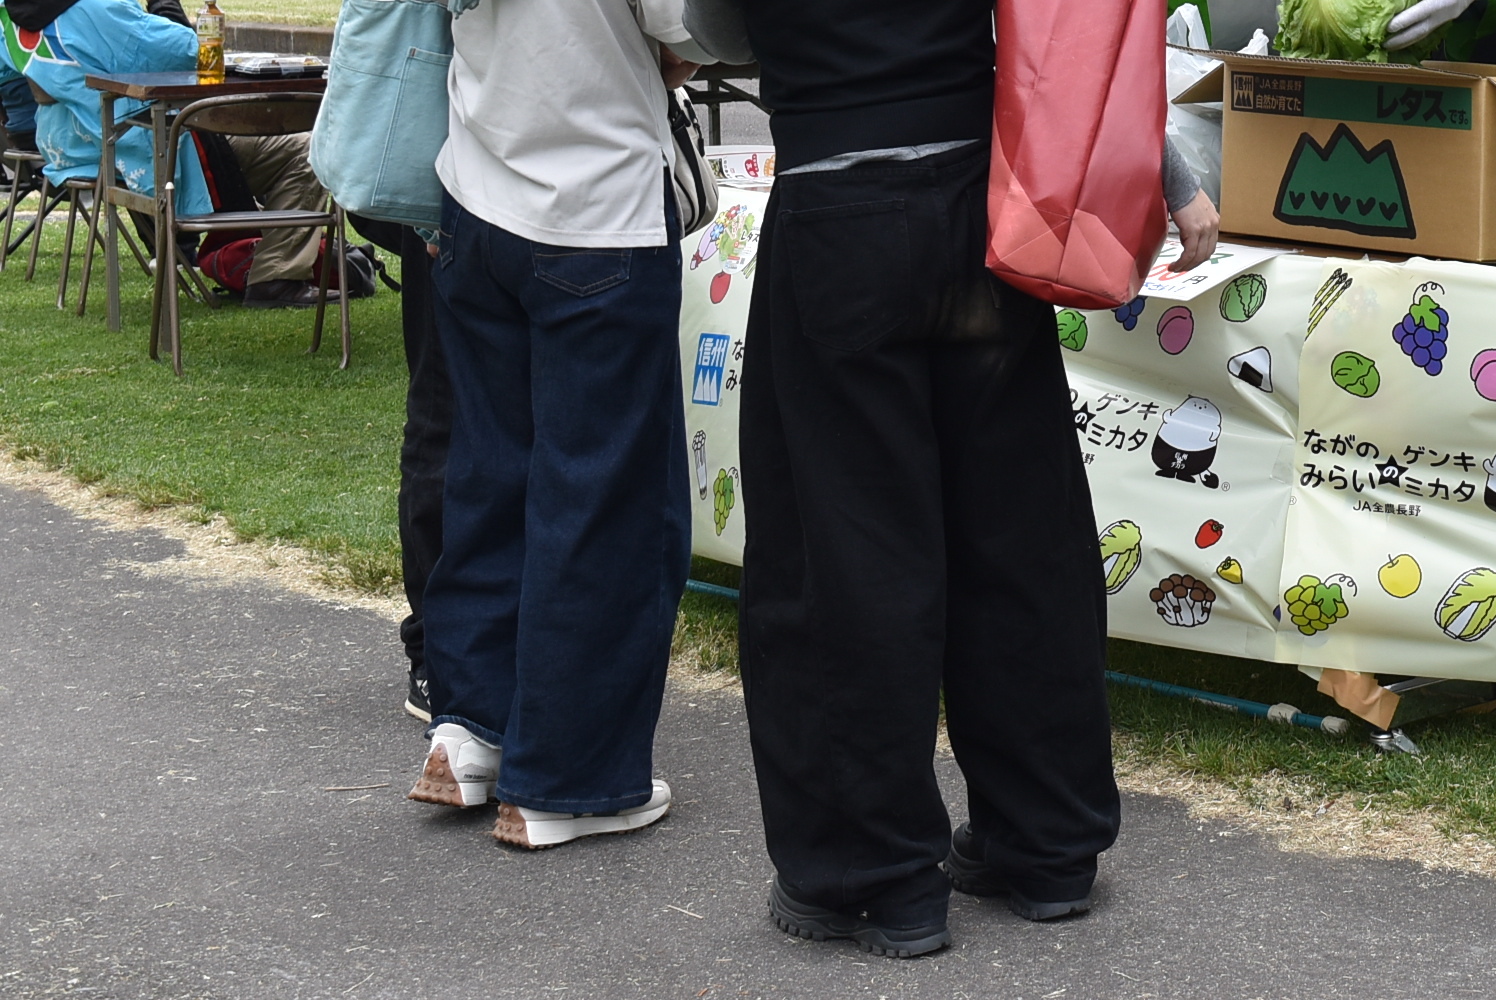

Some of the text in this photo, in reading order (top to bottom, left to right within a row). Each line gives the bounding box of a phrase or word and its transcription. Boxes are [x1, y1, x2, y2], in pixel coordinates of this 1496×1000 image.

[1235, 76, 1253, 91] 信州
[1259, 80, 1302, 90] JA全農長野
[1255, 94, 1302, 111] 自然が育てた
[698, 337, 727, 367] 信州
[1096, 393, 1159, 421] ゲンキ
[1087, 425, 1149, 451] ミカタ
[1303, 428, 1476, 472] ながの ゲンキ
[1300, 462, 1377, 493] みらい
[1404, 476, 1476, 502] ミカタ
[1353, 500, 1422, 517] JA全農長野
